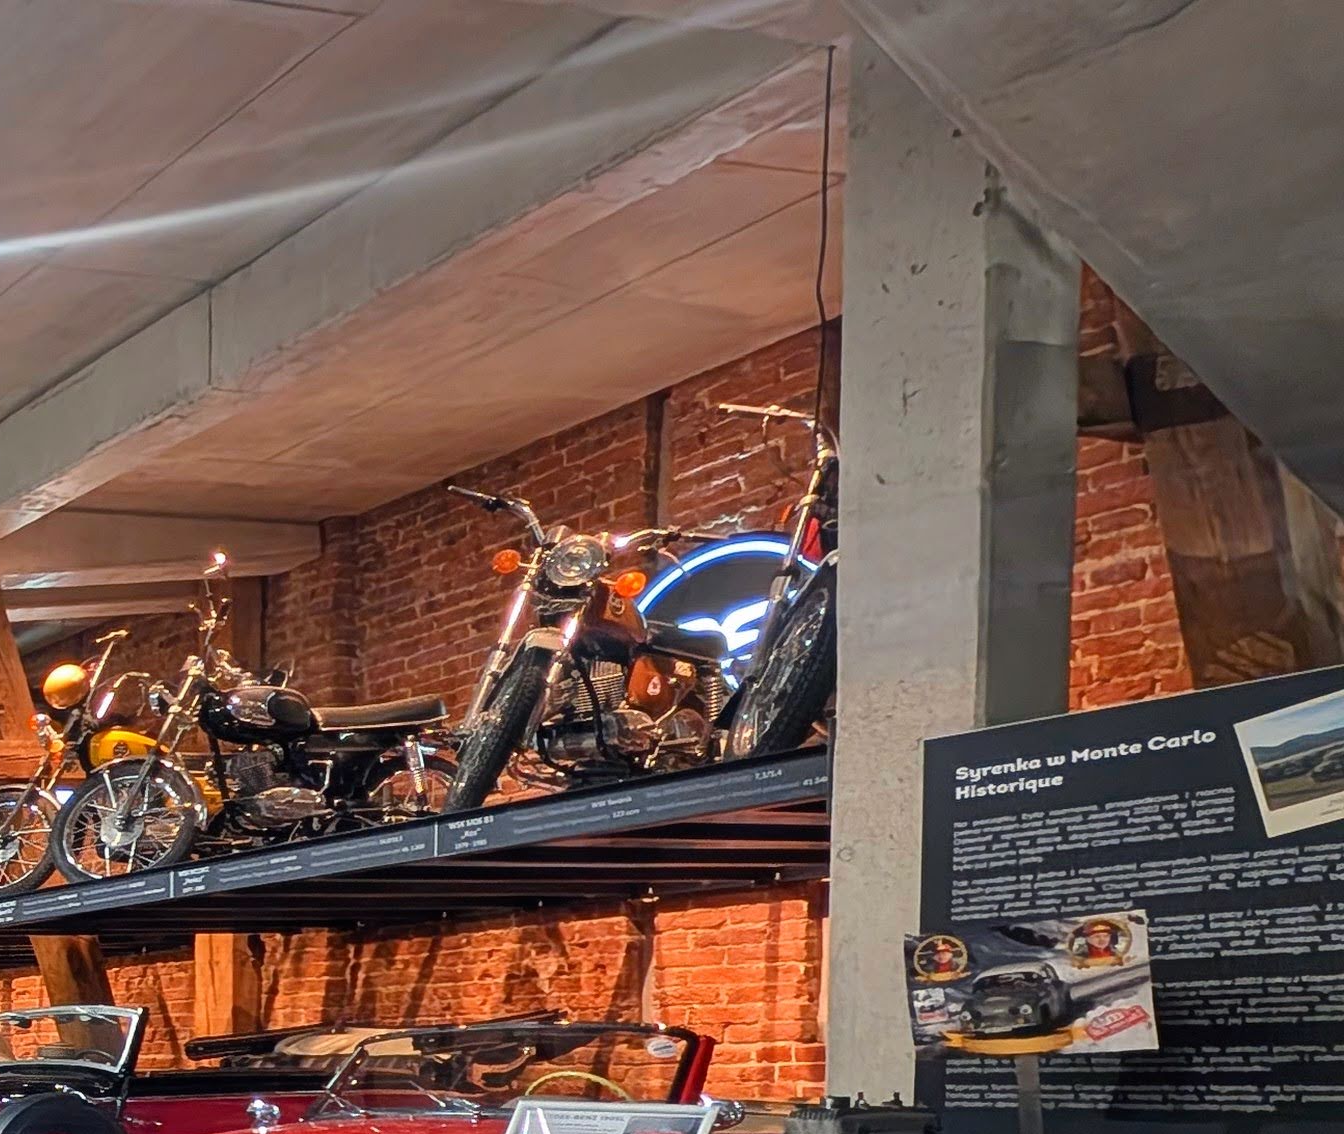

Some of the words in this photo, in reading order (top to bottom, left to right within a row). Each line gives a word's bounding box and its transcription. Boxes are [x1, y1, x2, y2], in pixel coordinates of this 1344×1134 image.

[955, 757, 1041, 782] Syrenka
[1047, 754, 1066, 768] w
[1071, 742, 1142, 764] Monte
[1147, 729, 1217, 751] Carlo
[955, 774, 1064, 800] Historique
